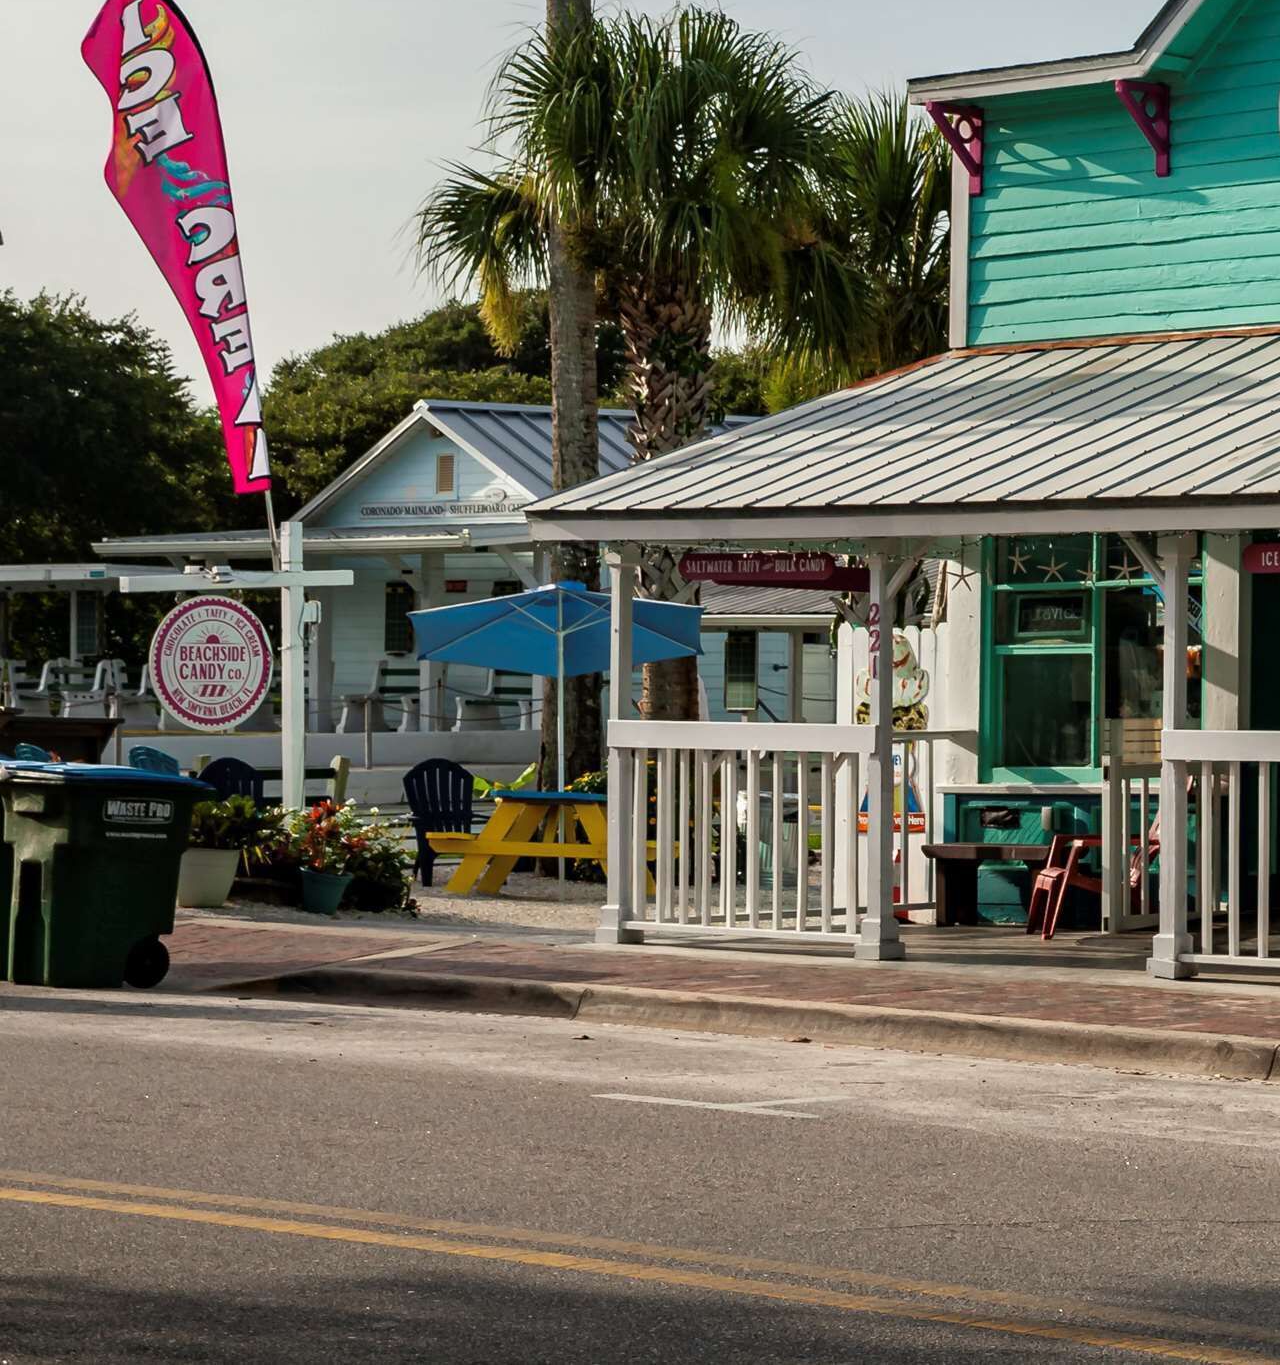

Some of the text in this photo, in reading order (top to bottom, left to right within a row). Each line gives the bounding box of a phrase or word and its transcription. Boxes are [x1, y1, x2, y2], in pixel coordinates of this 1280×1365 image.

[450, 503, 506, 515] SHUFFLEBOARD
[686, 558, 826, 574] SALTWATER TAFFY BULK CANDY
[1261, 551, 1280, 567] ICE
[163, 607, 261, 658] CHOCOLATE TAFFY ICE CREAM
[865, 602, 881, 679] 221
[179, 645, 246, 662] BEACHSIDE
[179, 663, 245, 680] CANDY CO.
[171, 687, 185, 705] NEW
[185, 699, 218, 717] SMYRNA
[243, 687, 254, 699] FL
[107, 800, 171, 818] WASTE PRO
